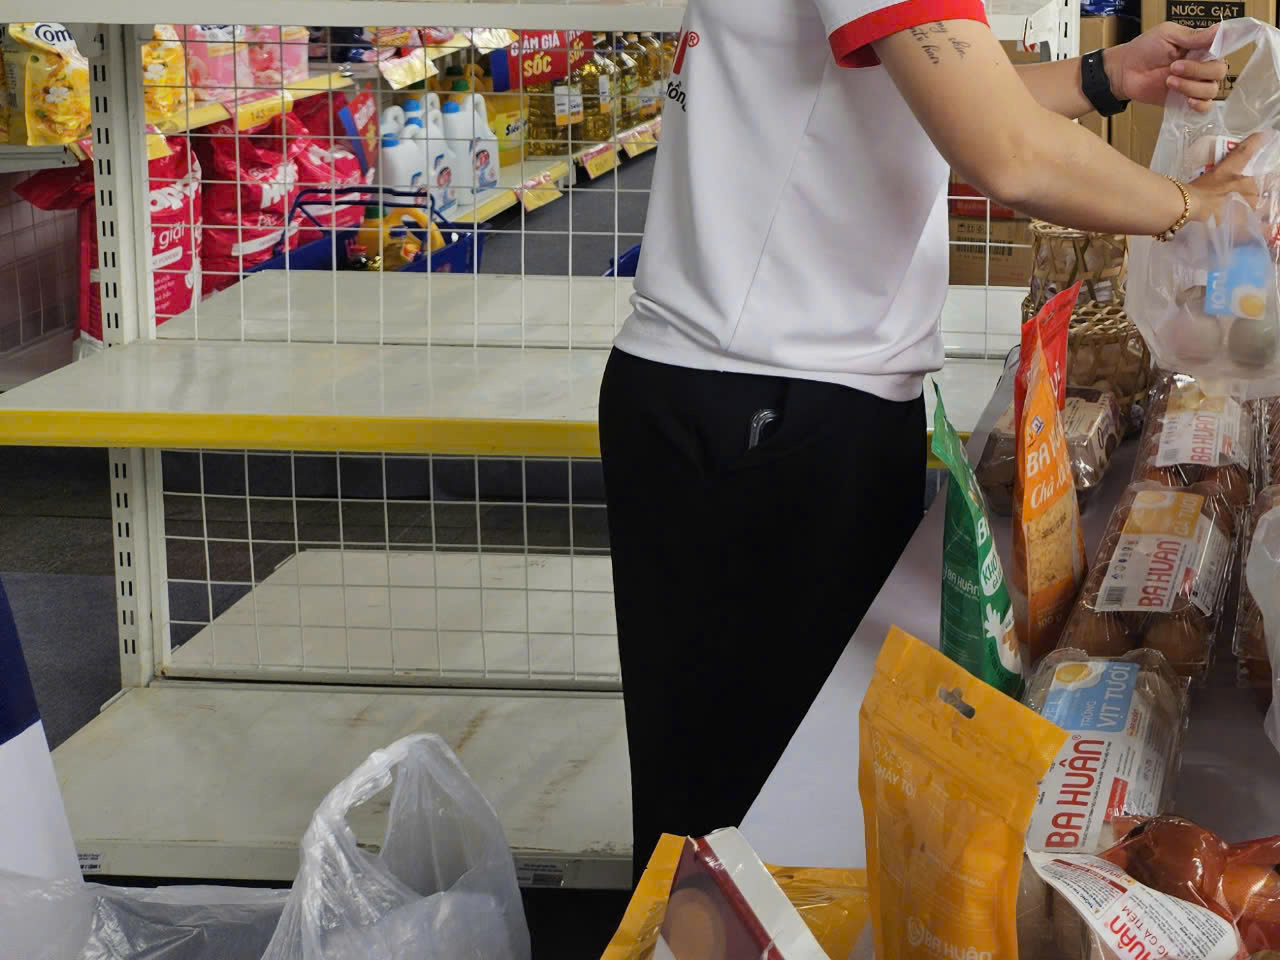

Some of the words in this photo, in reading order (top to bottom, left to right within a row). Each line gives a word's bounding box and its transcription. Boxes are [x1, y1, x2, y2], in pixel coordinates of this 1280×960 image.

[1171, 2, 1205, 16] NƯỚC
[1211, 4, 1239, 19] GIẶT
[511, 34, 540, 57] GẢM
[1146, 539, 1182, 584] HUÂN
[1138, 584, 1166, 608] BA
[1104, 665, 1131, 700] TƯƠI
[1096, 702, 1125, 728] VỊT
[1056, 739, 1105, 807] HUÂN
[1045, 812, 1086, 849] BA
